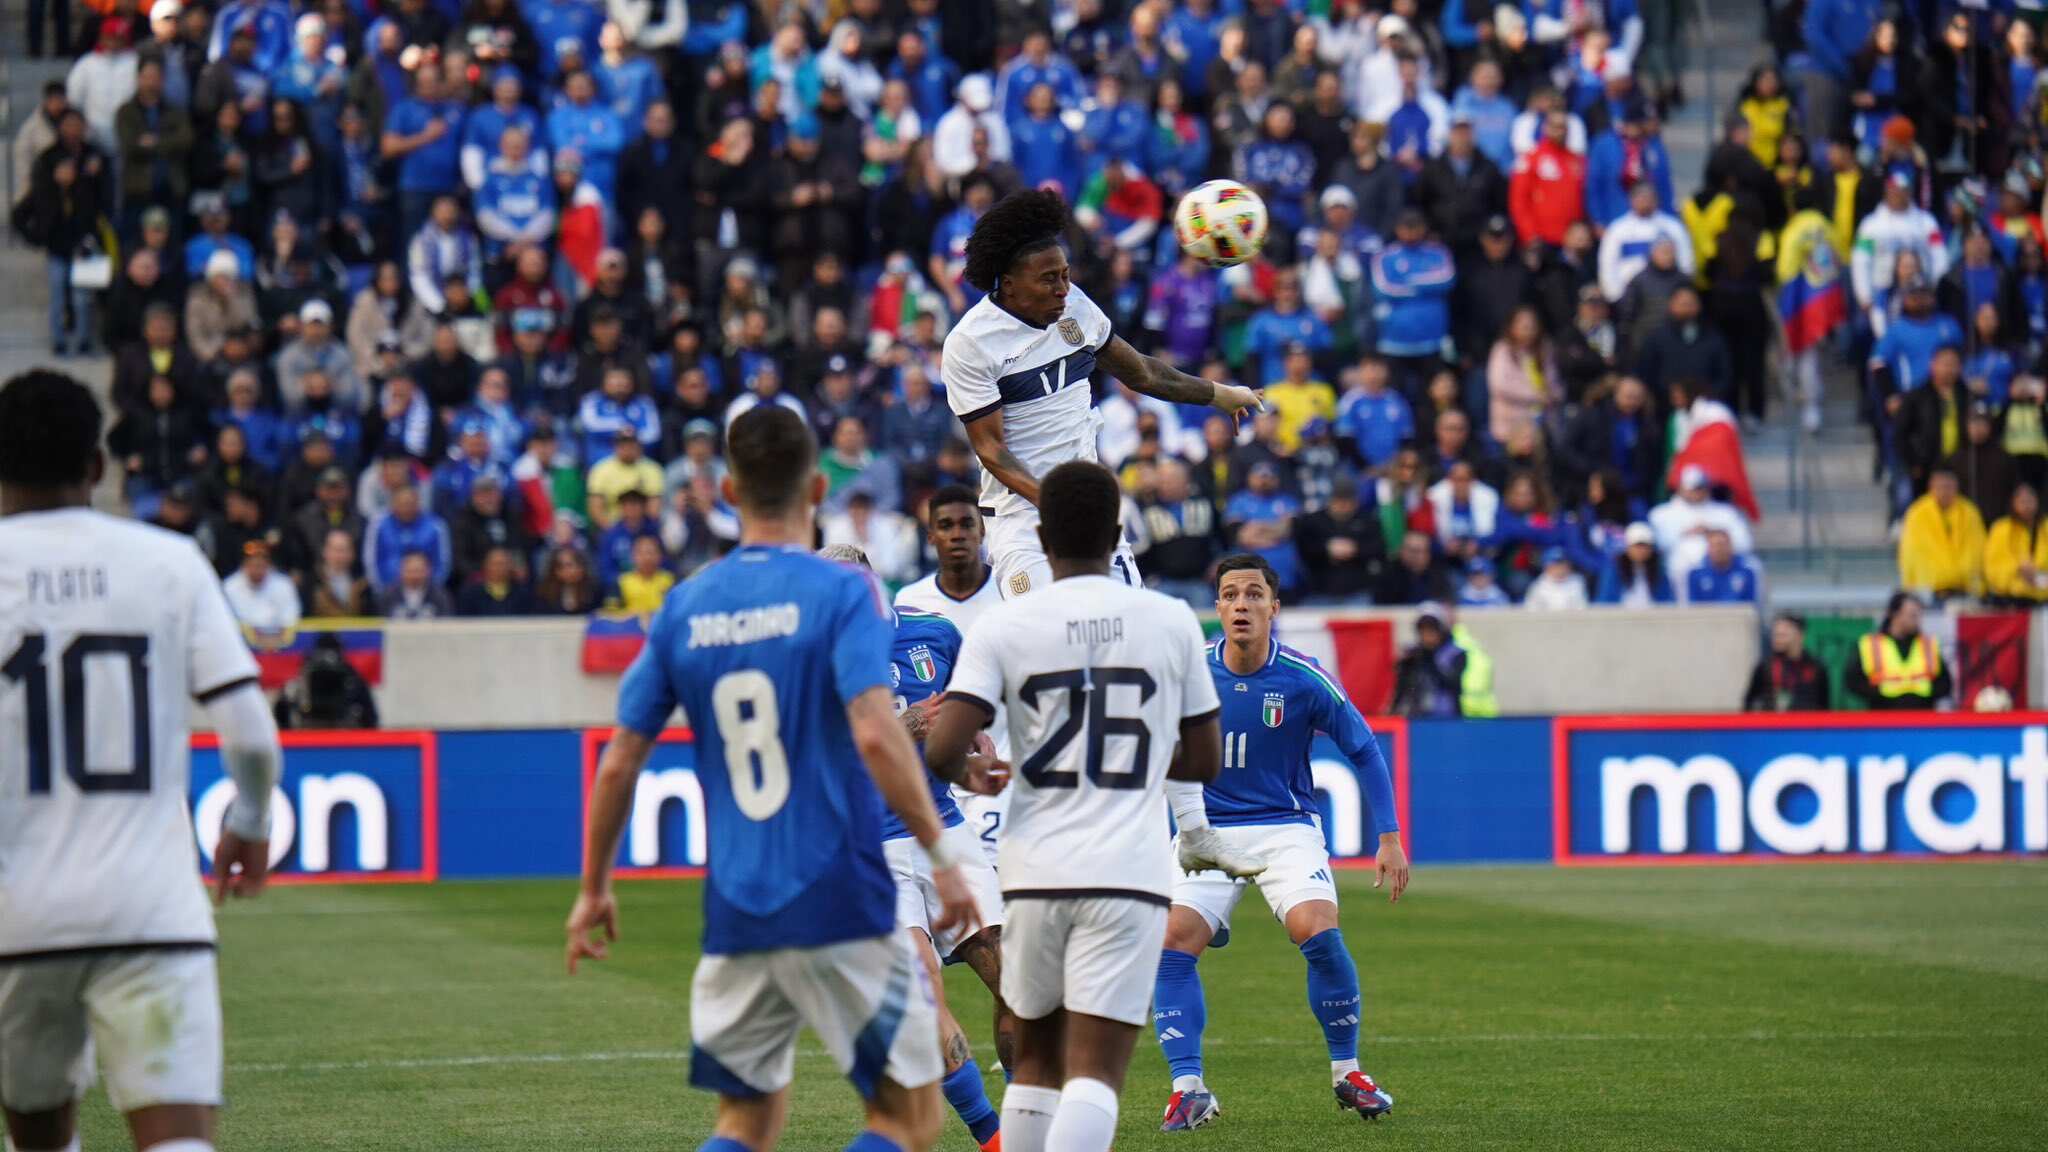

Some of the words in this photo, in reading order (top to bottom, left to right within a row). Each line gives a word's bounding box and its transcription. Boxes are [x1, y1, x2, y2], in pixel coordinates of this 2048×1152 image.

[26, 566, 109, 605] PLATA
[1066, 618, 1124, 645] MINDA
[1, 633, 151, 794] 10
[712, 668, 791, 821] 8
[1019, 667, 1157, 789] 26
[1224, 731, 1247, 768] 11
